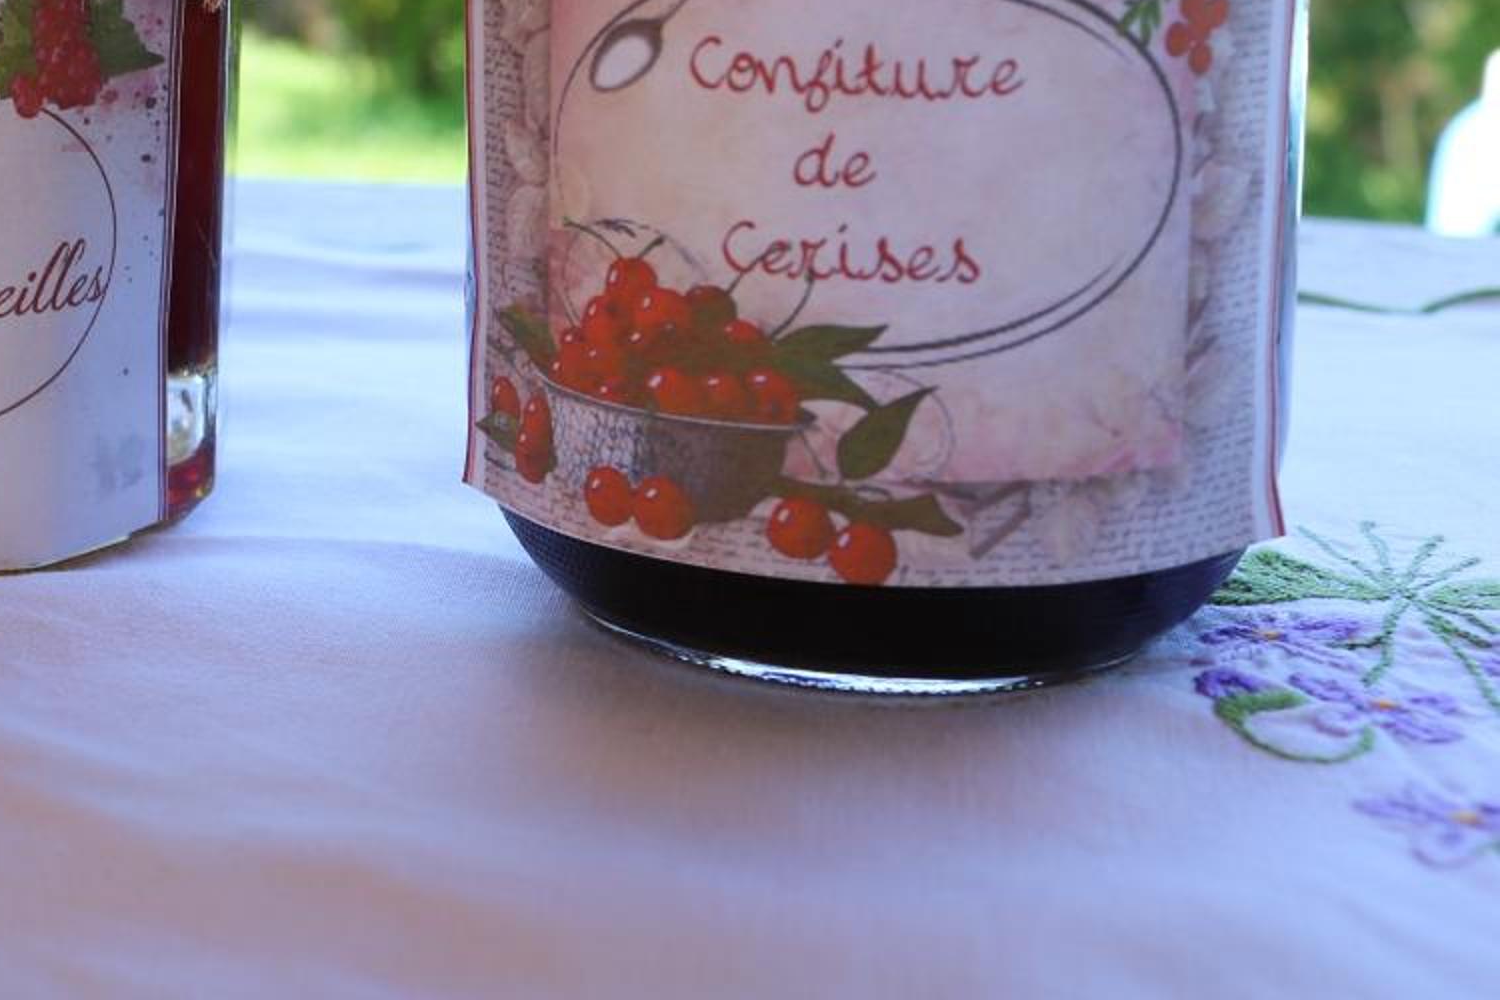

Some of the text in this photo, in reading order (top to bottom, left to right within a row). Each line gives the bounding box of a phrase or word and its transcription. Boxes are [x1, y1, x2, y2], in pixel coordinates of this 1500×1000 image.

[689, 36, 1026, 114] Confiture
[792, 132, 877, 189] de
[721, 220, 981, 284] Cerises
